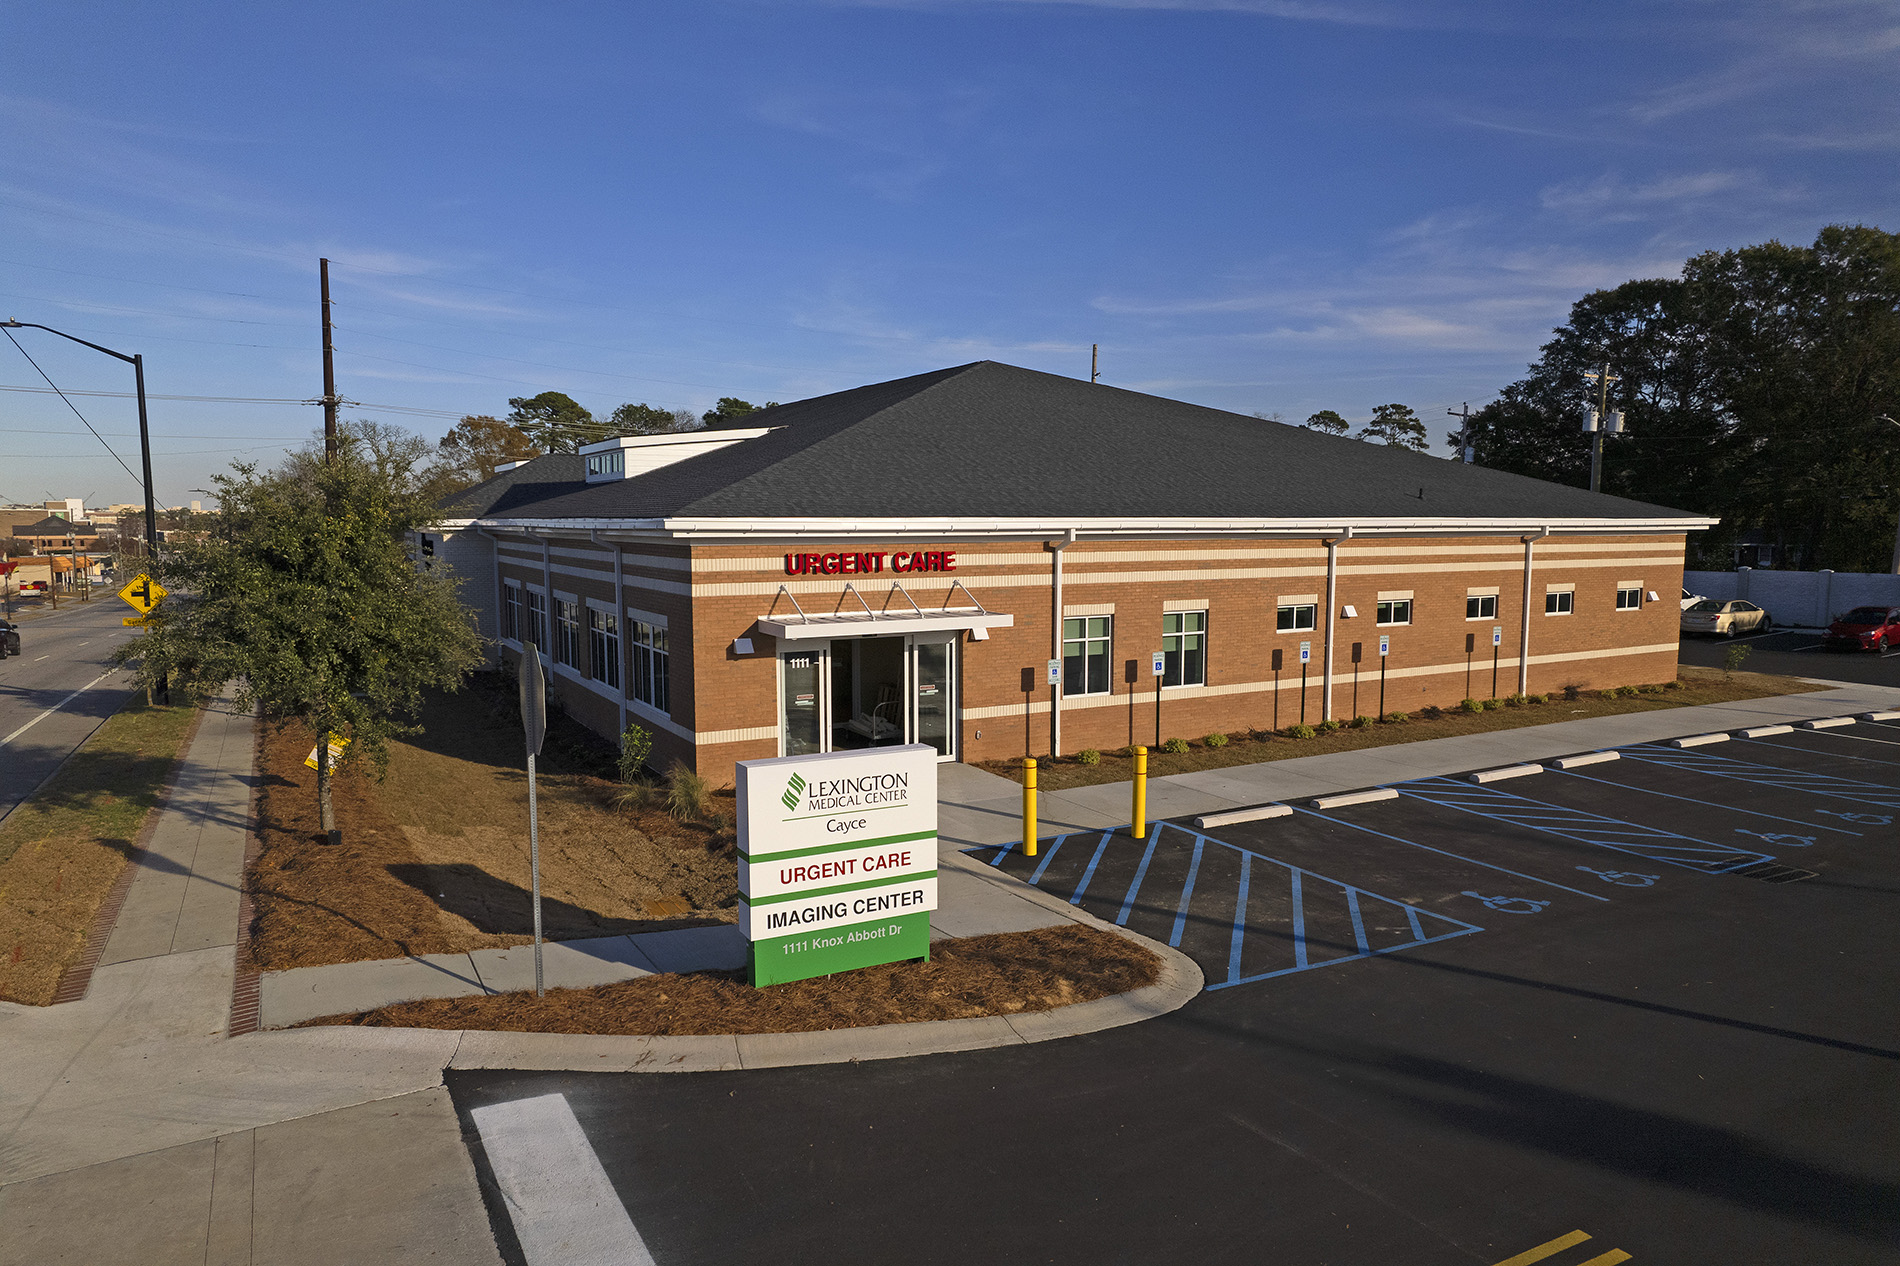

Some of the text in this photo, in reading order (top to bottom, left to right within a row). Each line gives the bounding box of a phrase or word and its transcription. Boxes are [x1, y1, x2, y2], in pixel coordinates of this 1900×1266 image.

[784, 550, 957, 575] URGENT CARE
[790, 657, 810, 669] 1111
[809, 772, 908, 798] LEXINGTON
[808, 789, 908, 811] MEDICAL CENTER
[826, 817, 867, 834] Cayce
[780, 851, 912, 884] URGENT CARE
[767, 889, 924, 930] IMAGING CENTER
[782, 924, 903, 955] 1111 Knox Abbott Dr
